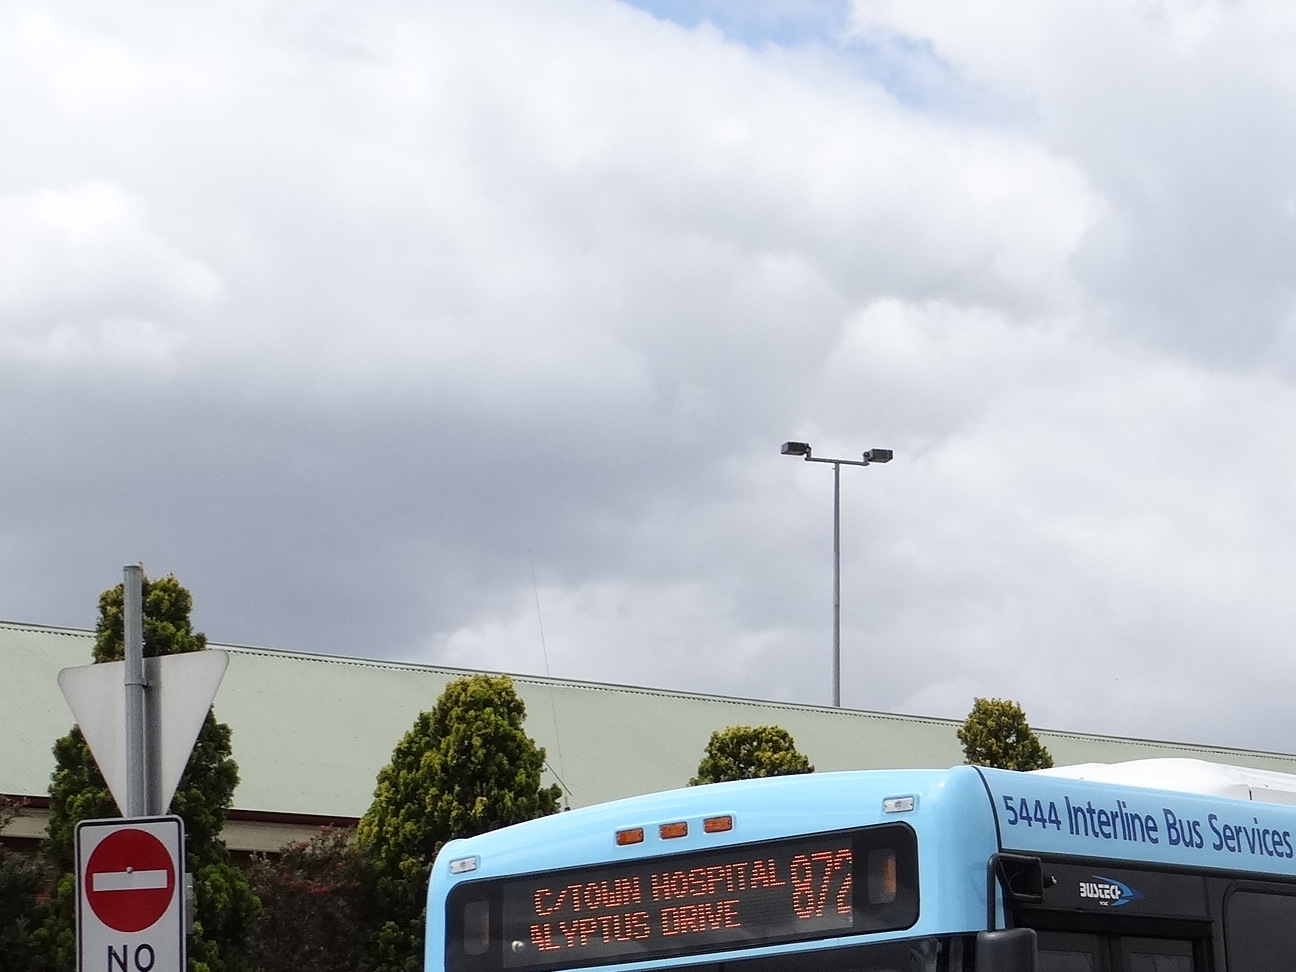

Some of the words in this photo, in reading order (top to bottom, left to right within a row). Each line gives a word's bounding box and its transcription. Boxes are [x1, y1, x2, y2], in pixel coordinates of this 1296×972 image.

[1002, 795, 1061, 830] 5444
[1064, 796, 1158, 845] Interline
[1162, 808, 1204, 849] Bus
[1208, 813, 1294, 859] Services
[534, 876, 642, 917] C/TOWN
[651, 859, 786, 901] HOSPITAL
[791, 848, 852, 919] 872
[661, 899, 741, 936] DRIVE
